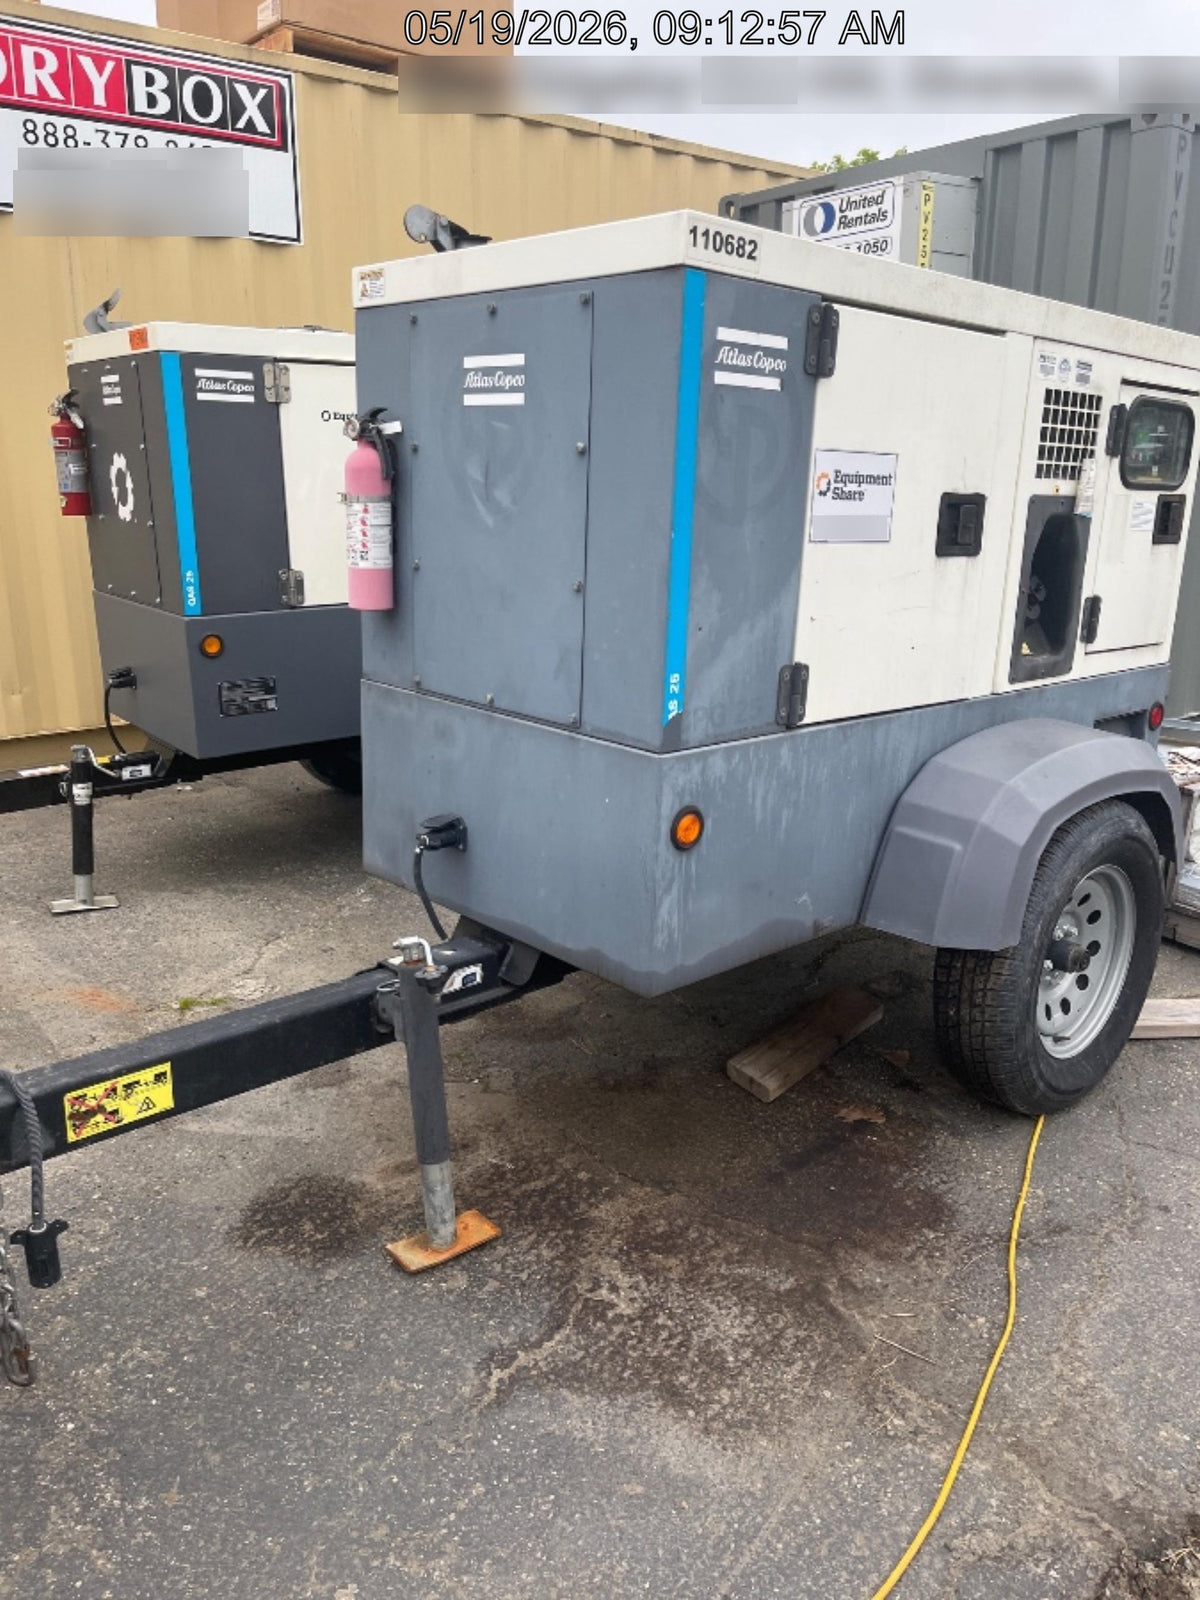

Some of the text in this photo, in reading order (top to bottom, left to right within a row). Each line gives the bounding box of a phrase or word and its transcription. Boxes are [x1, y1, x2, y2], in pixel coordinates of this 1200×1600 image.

[0, 43, 272, 134] RYBOX
[838, 190, 886, 214] United
[837, 207, 889, 231] Rentals
[689, 225, 759, 261] 110682
[714, 345, 788, 375] Atlas Copco
[463, 370, 526, 390] Atlas Copco
[833, 468, 894, 488] Equipment
[831, 486, 866, 502] Share
